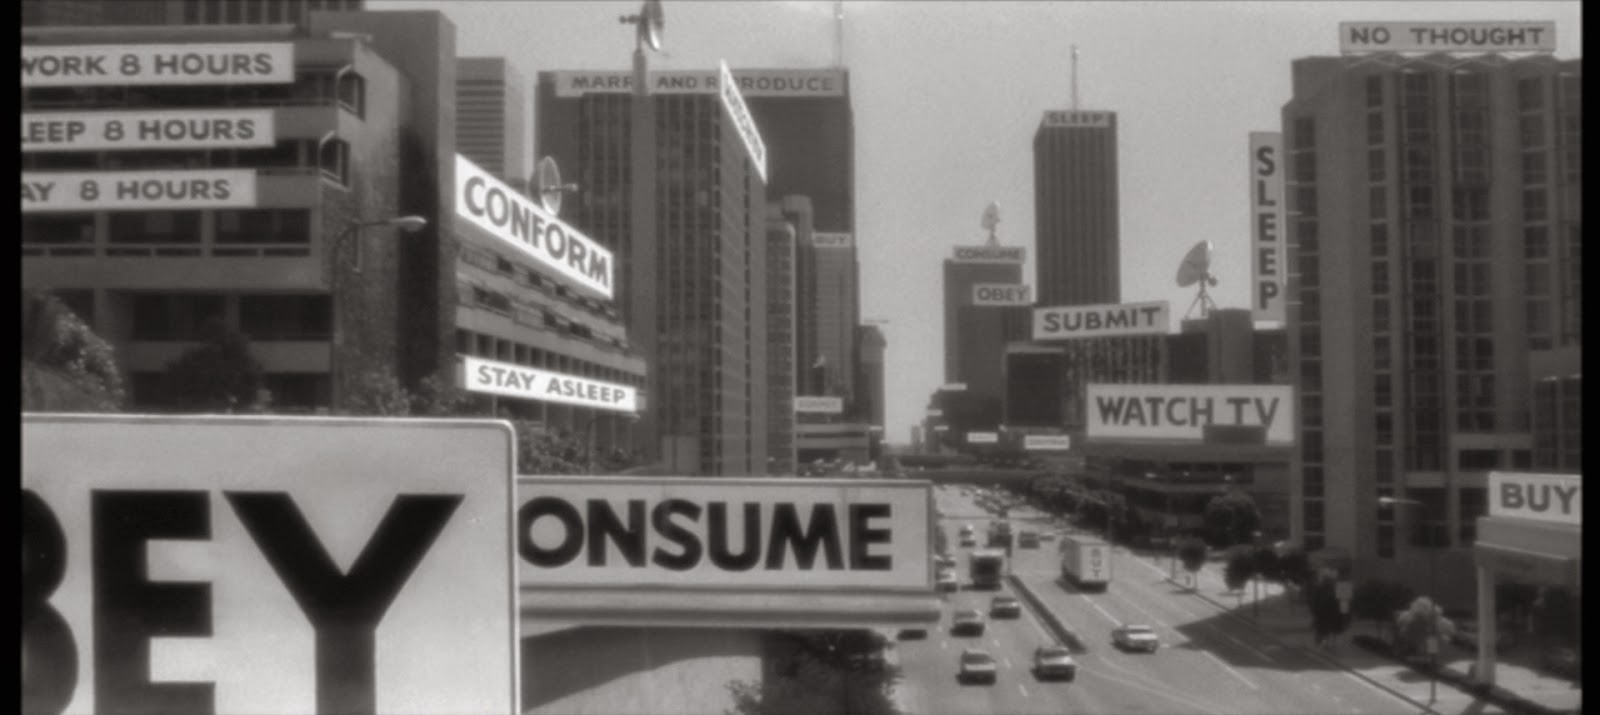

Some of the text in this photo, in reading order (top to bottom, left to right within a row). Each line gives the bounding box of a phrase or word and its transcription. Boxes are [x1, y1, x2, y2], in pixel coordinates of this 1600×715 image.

[1351, 27, 1545, 46] NO THOUGHT
[120, 54, 141, 76] 8
[155, 53, 273, 76] HOURS
[570, 75, 833, 91] MARR AND RRODUCE
[22, 117, 256, 143] EEP 8 HOURS
[80, 179, 100, 202] 8
[117, 179, 231, 202] HOURS
[464, 176, 609, 288] CONFORM
[1257, 145, 1279, 311] SLEEP
[977, 286, 1029, 301] OBEY
[1043, 305, 1161, 333] SUBMIT
[477, 364, 626, 404] STAY ASLEEP
[1096, 396, 1281, 429] WATCH TV
[1501, 483, 1578, 515] BUY
